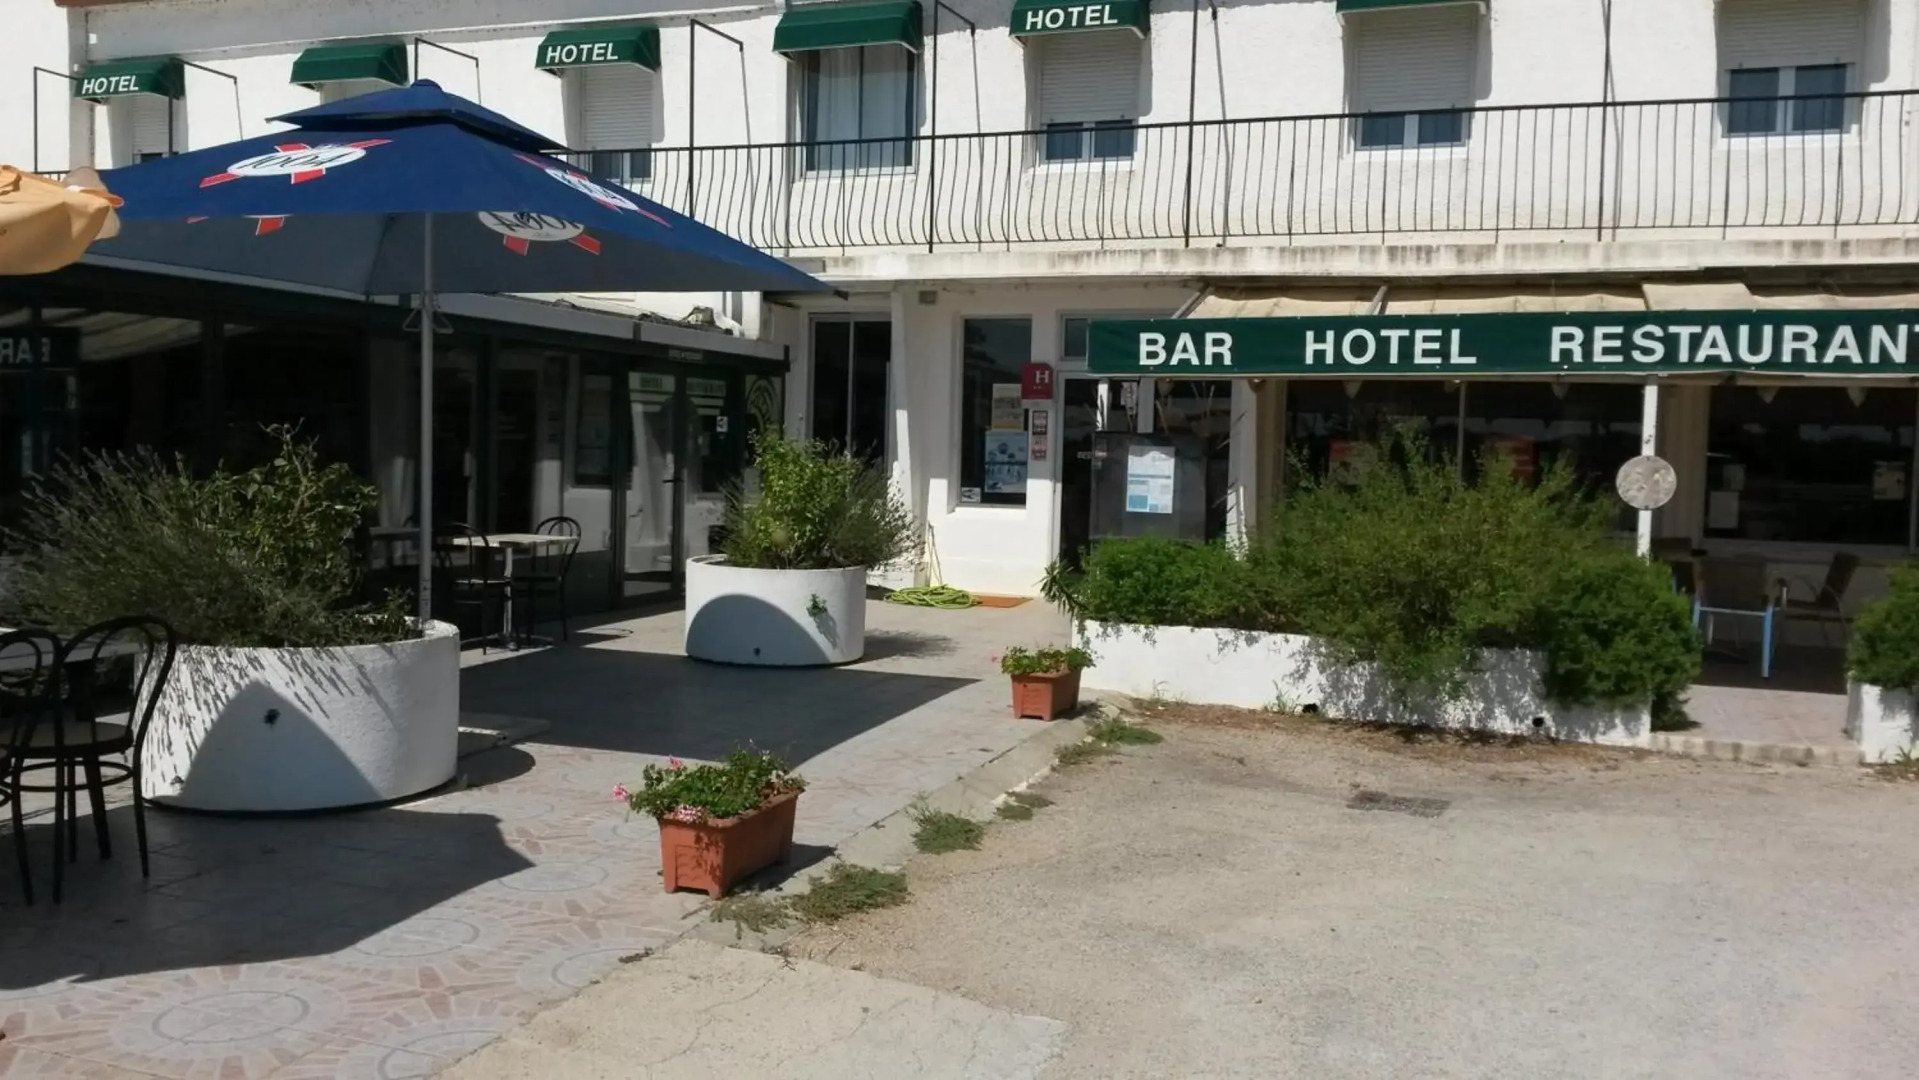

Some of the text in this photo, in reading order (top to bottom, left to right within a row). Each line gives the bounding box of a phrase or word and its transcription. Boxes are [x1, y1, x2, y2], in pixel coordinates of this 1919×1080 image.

[1025, 4, 1118, 30] HOTEL
[545, 42, 618, 64] HOTEL
[81, 75, 139, 95] HOTEL
[1138, 332, 1234, 366] BAR
[1304, 328, 1477, 365] HOTEL
[1035, 370, 1050, 384] H
